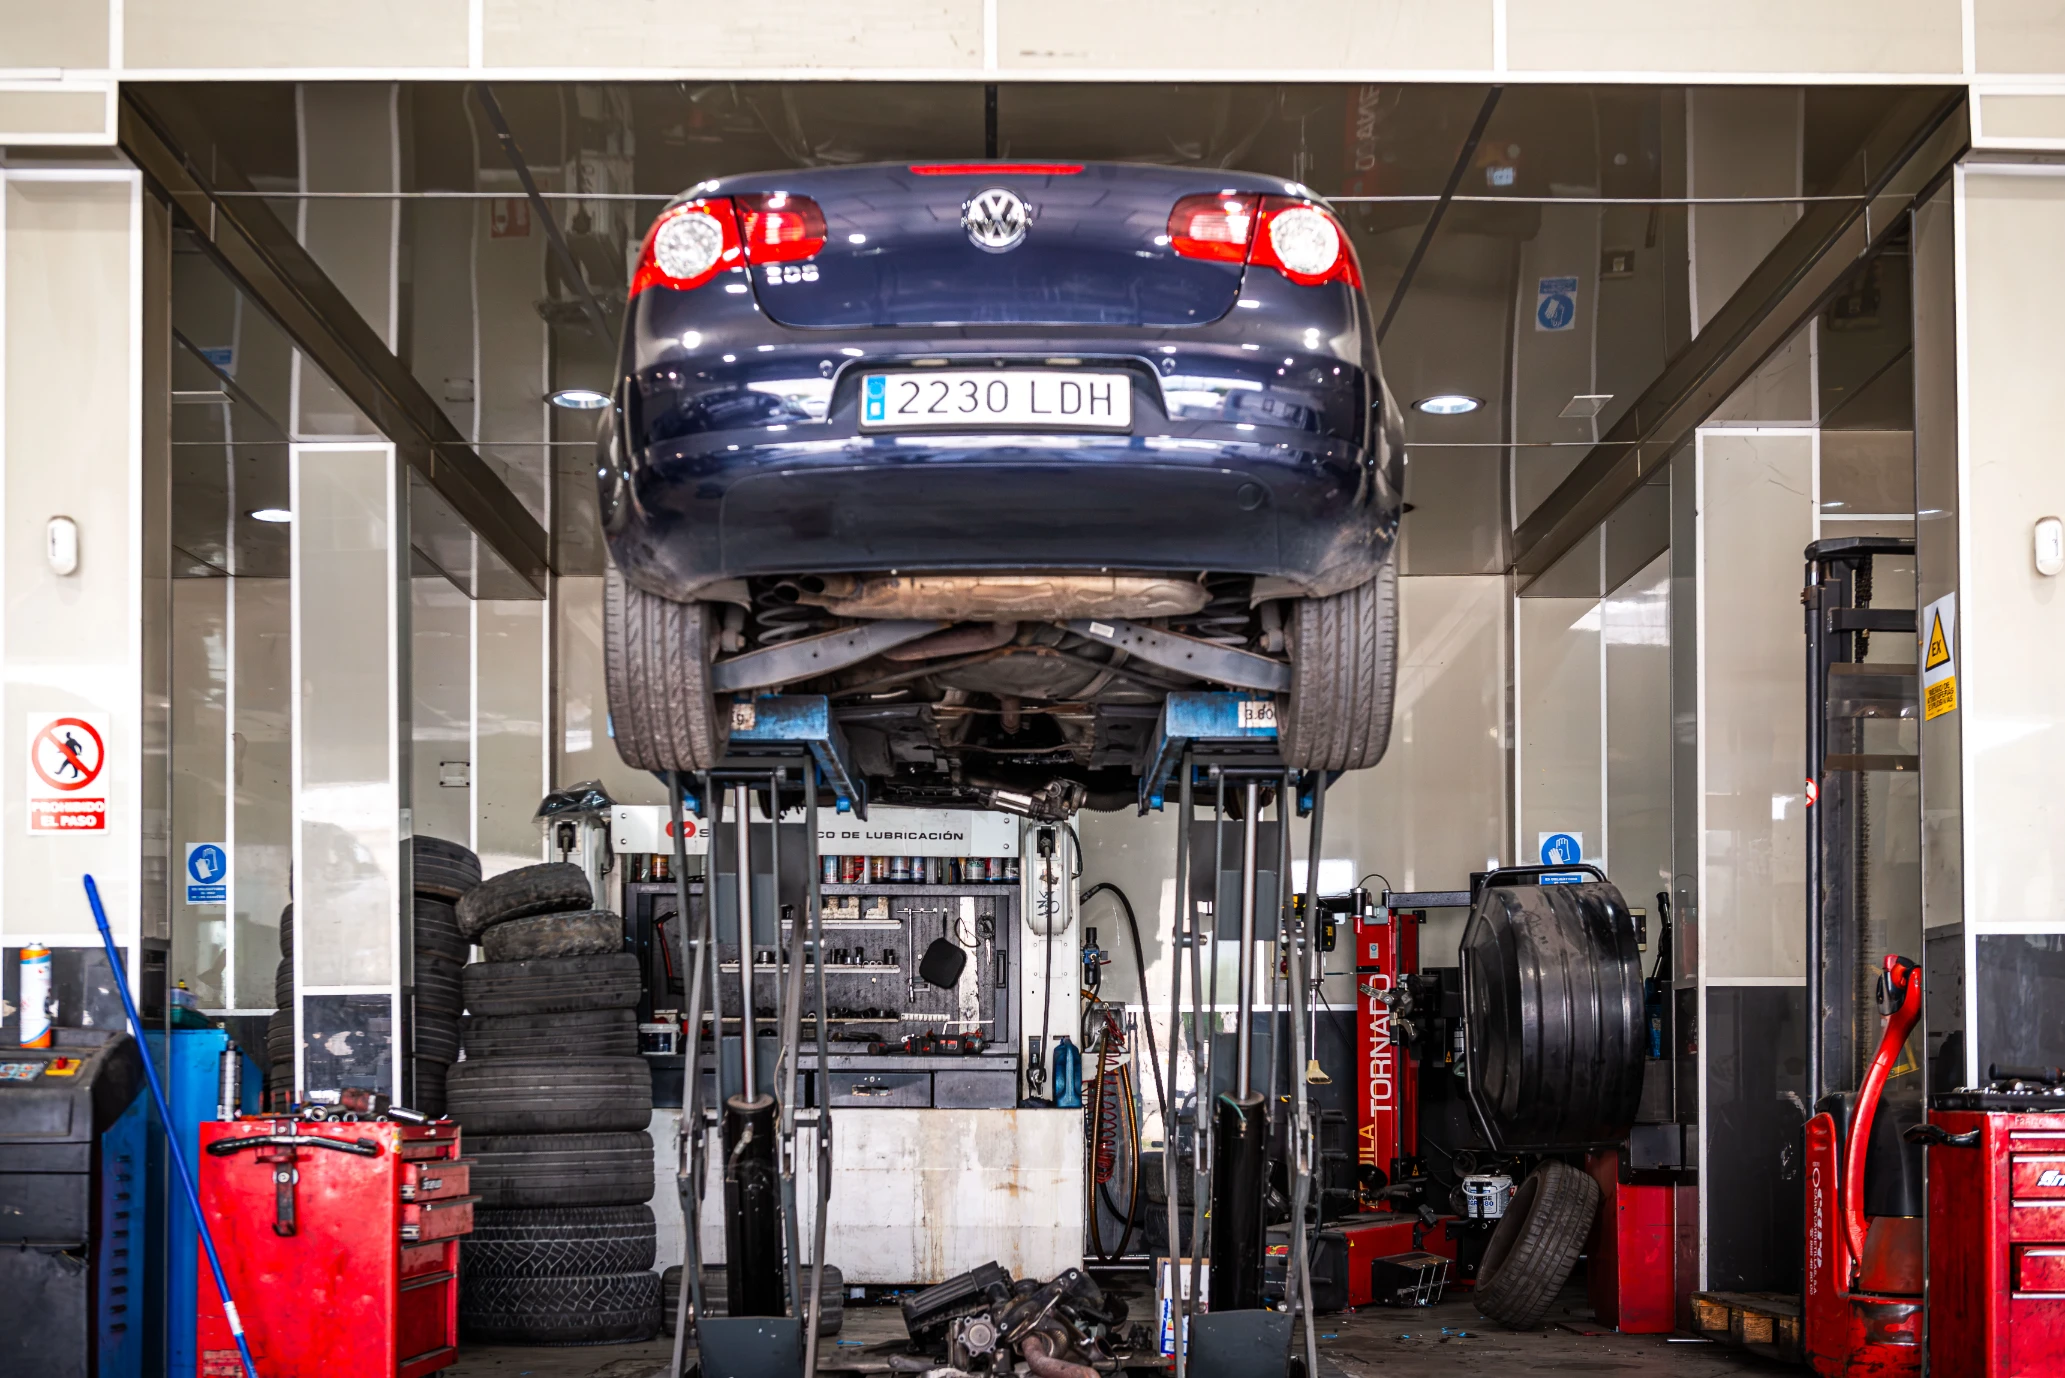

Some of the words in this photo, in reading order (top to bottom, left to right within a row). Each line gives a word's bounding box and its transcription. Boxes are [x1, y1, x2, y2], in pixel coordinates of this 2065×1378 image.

[897, 379, 1009, 414] 2230
[1030, 380, 1112, 416] LDH
[1931, 639, 1942, 657] EX
[41, 815, 60, 827] EL
[60, 815, 97, 827] PASO
[841, 831, 860, 839] DE
[866, 830, 964, 840] LUBRICACIÓN
[1369, 974, 1392, 1118] TORNADO
